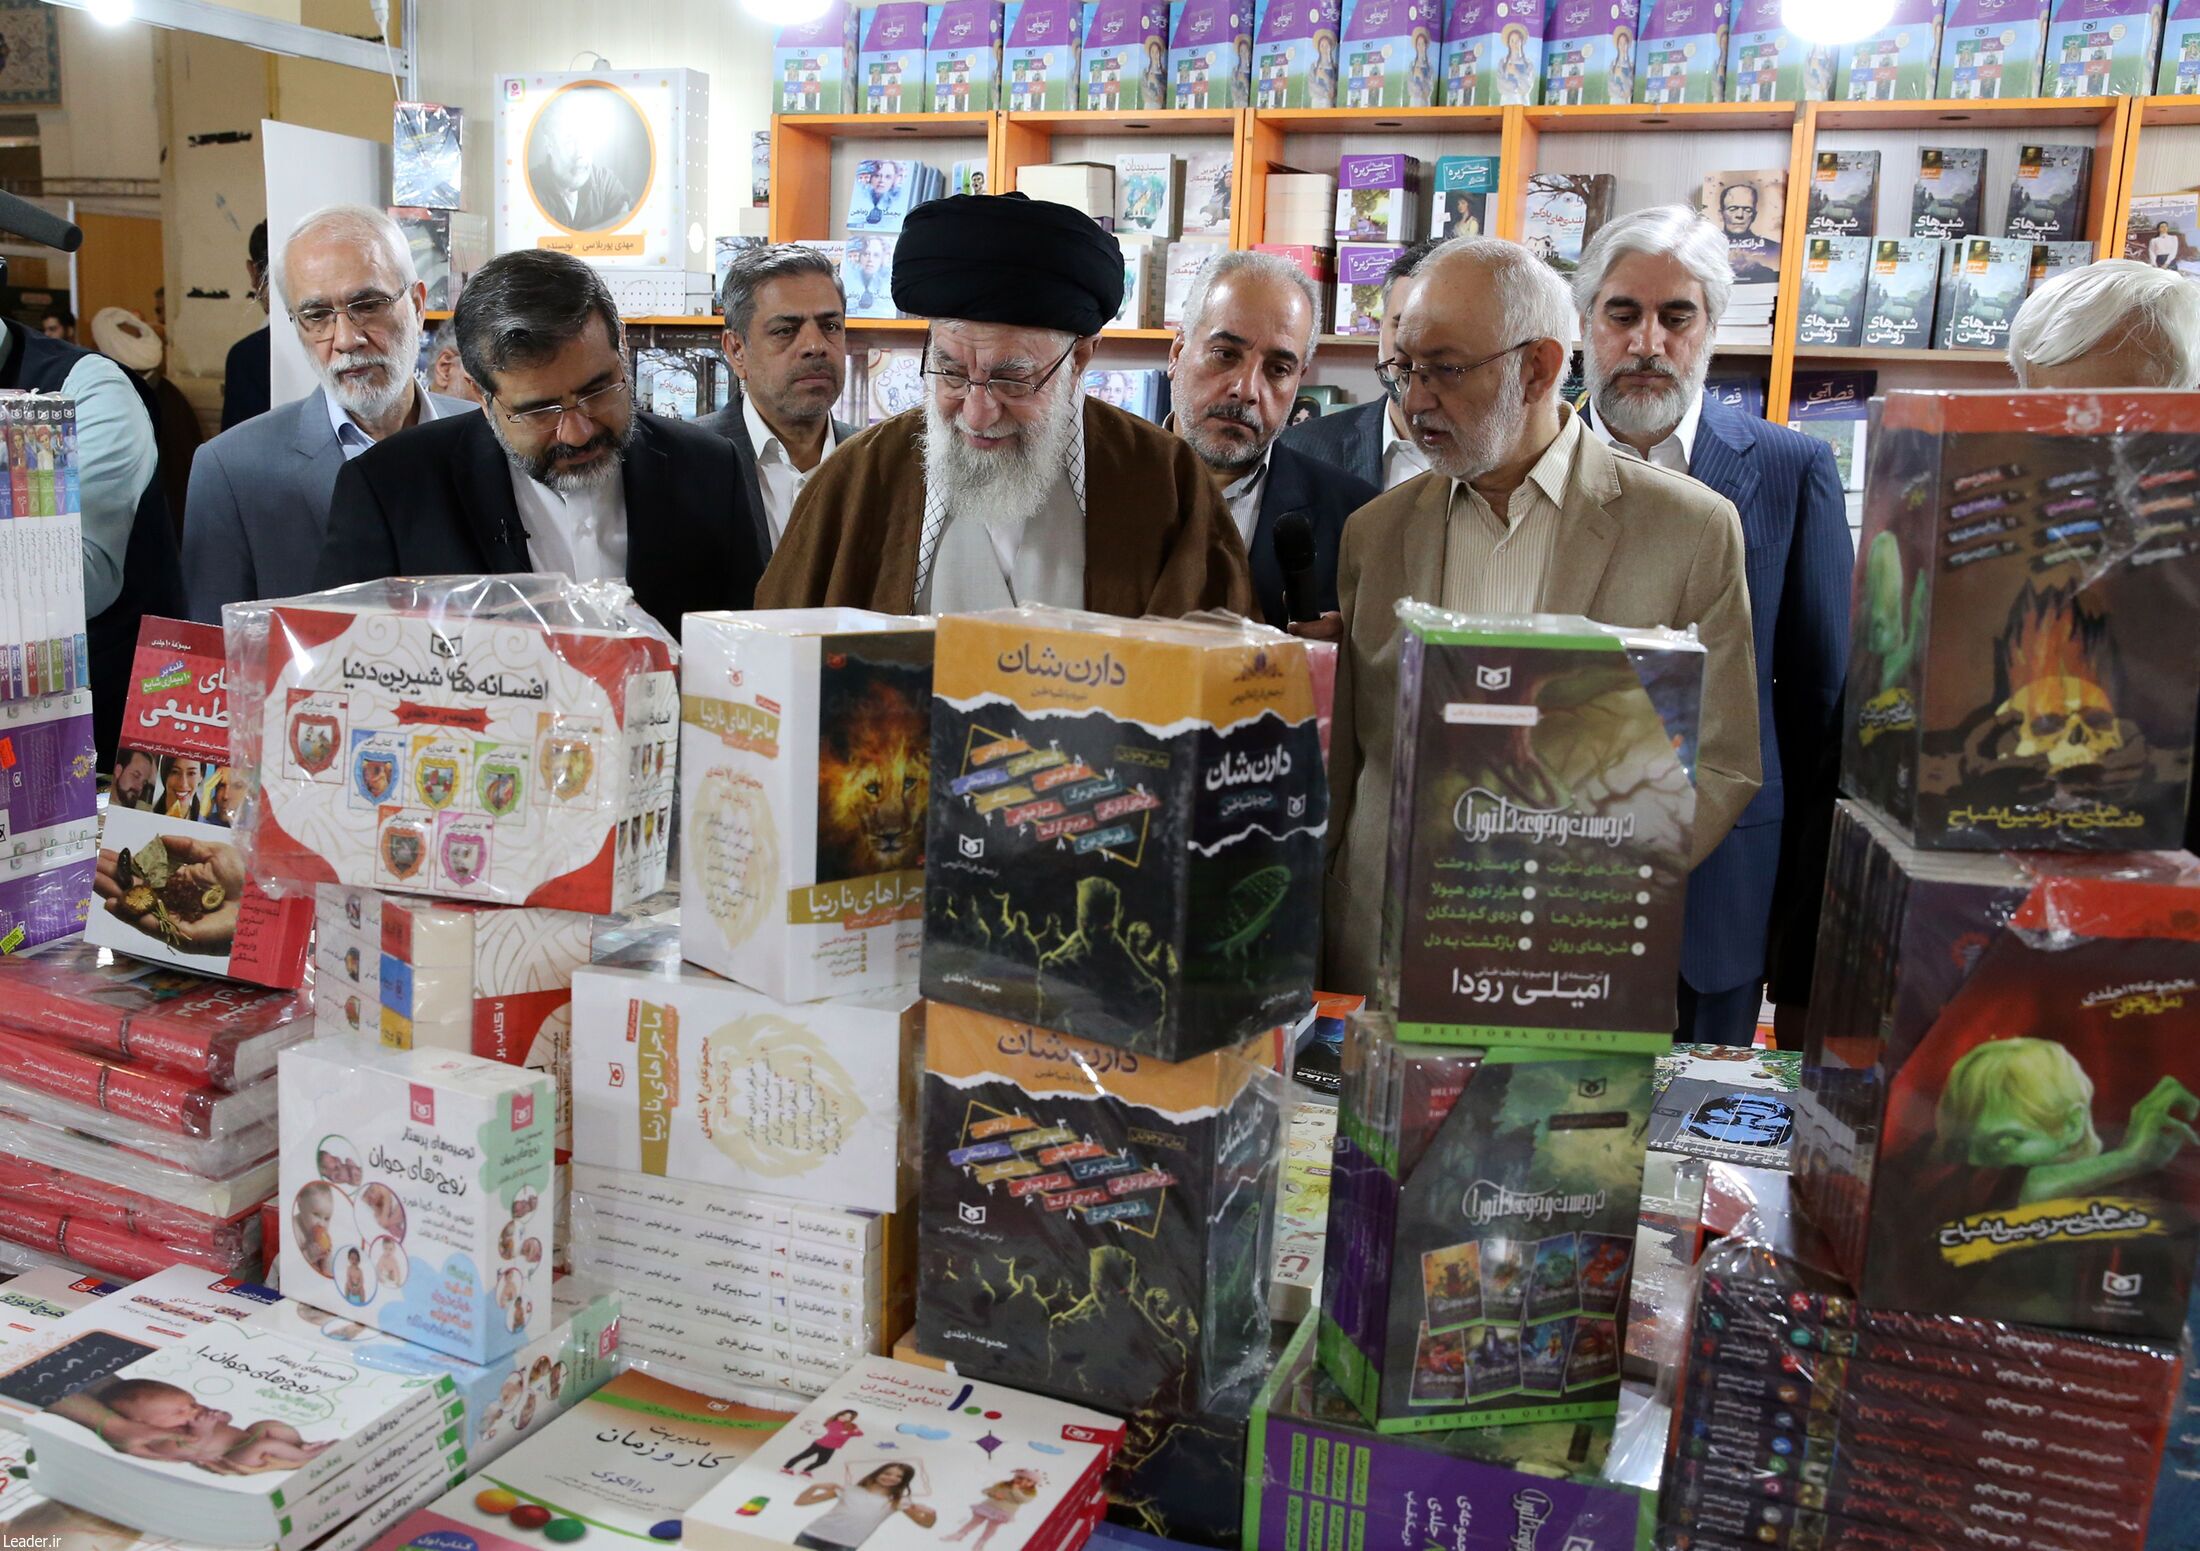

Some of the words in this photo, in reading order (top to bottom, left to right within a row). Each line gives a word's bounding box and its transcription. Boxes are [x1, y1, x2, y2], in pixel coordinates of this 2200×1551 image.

[1801, 314, 1850, 329] شب‌های
[1868, 315, 1918, 330] شب‌های
[1958, 315, 2009, 331] شب‌های
[1800, 328, 1838, 343] روشن
[1867, 329, 1905, 344] روشن
[1957, 329, 1995, 344] روشن
[1808, 381, 1833, 400] آبی
[169, 660, 185, 673] غلبه
[997, 642, 1064, 677] شان
[1064, 652, 1127, 687] دارن
[341, 657, 378, 689] دنیا
[378, 665, 443, 696] شیرین
[139, 696, 232, 733] طبیعی
[700, 700, 726, 728] نارنیا
[726, 707, 777, 741] ماجراهای
[1104, 767, 1115, 782] ۷
[1205, 749, 1250, 792] شان
[1250, 743, 1292, 784] دارن
[807, 886, 855, 918] نارنیا
[855, 878, 923, 914] جراهای
[1451, 967, 1504, 1002] رودا
[1512, 970, 1610, 1008] امیلی
[996, 1028, 1068, 1062] شان
[1423, 1026, 1529, 1040] DELTORA
[1545, 1030, 1620, 1044] QUEST
[643, 1010, 669, 1099] ماجراهای
[643, 1098, 669, 1142] نارنیا
[368, 1145, 407, 1178] جوان
[432, 1154, 443, 1166] به
[1117, 1147, 1128, 1159] ۷
[407, 1155, 468, 1196] زوج‌های
[1066, 1208, 1076, 1220] ۸
[1939, 1219, 2003, 1246] اشباح
[942, 1327, 969, 1341] جلدی
[977, 1335, 1008, 1350] مجموعه
[249, 1366, 322, 1395] زوج‌های
[860, 1381, 905, 1400] دختران
[865, 1370, 911, 1390] شناخت
[1413, 1409, 1508, 1427] DELTORA
[1521, 1404, 1586, 1419] QUEST
[596, 1427, 654, 1456] زمان
[649, 1424, 711, 1448] مدیریت
[651, 1449, 674, 1462] و
[671, 1452, 735, 1472] کار
[416, 1534, 439, 1547] اول
[445, 1537, 473, 1551] کتاب
